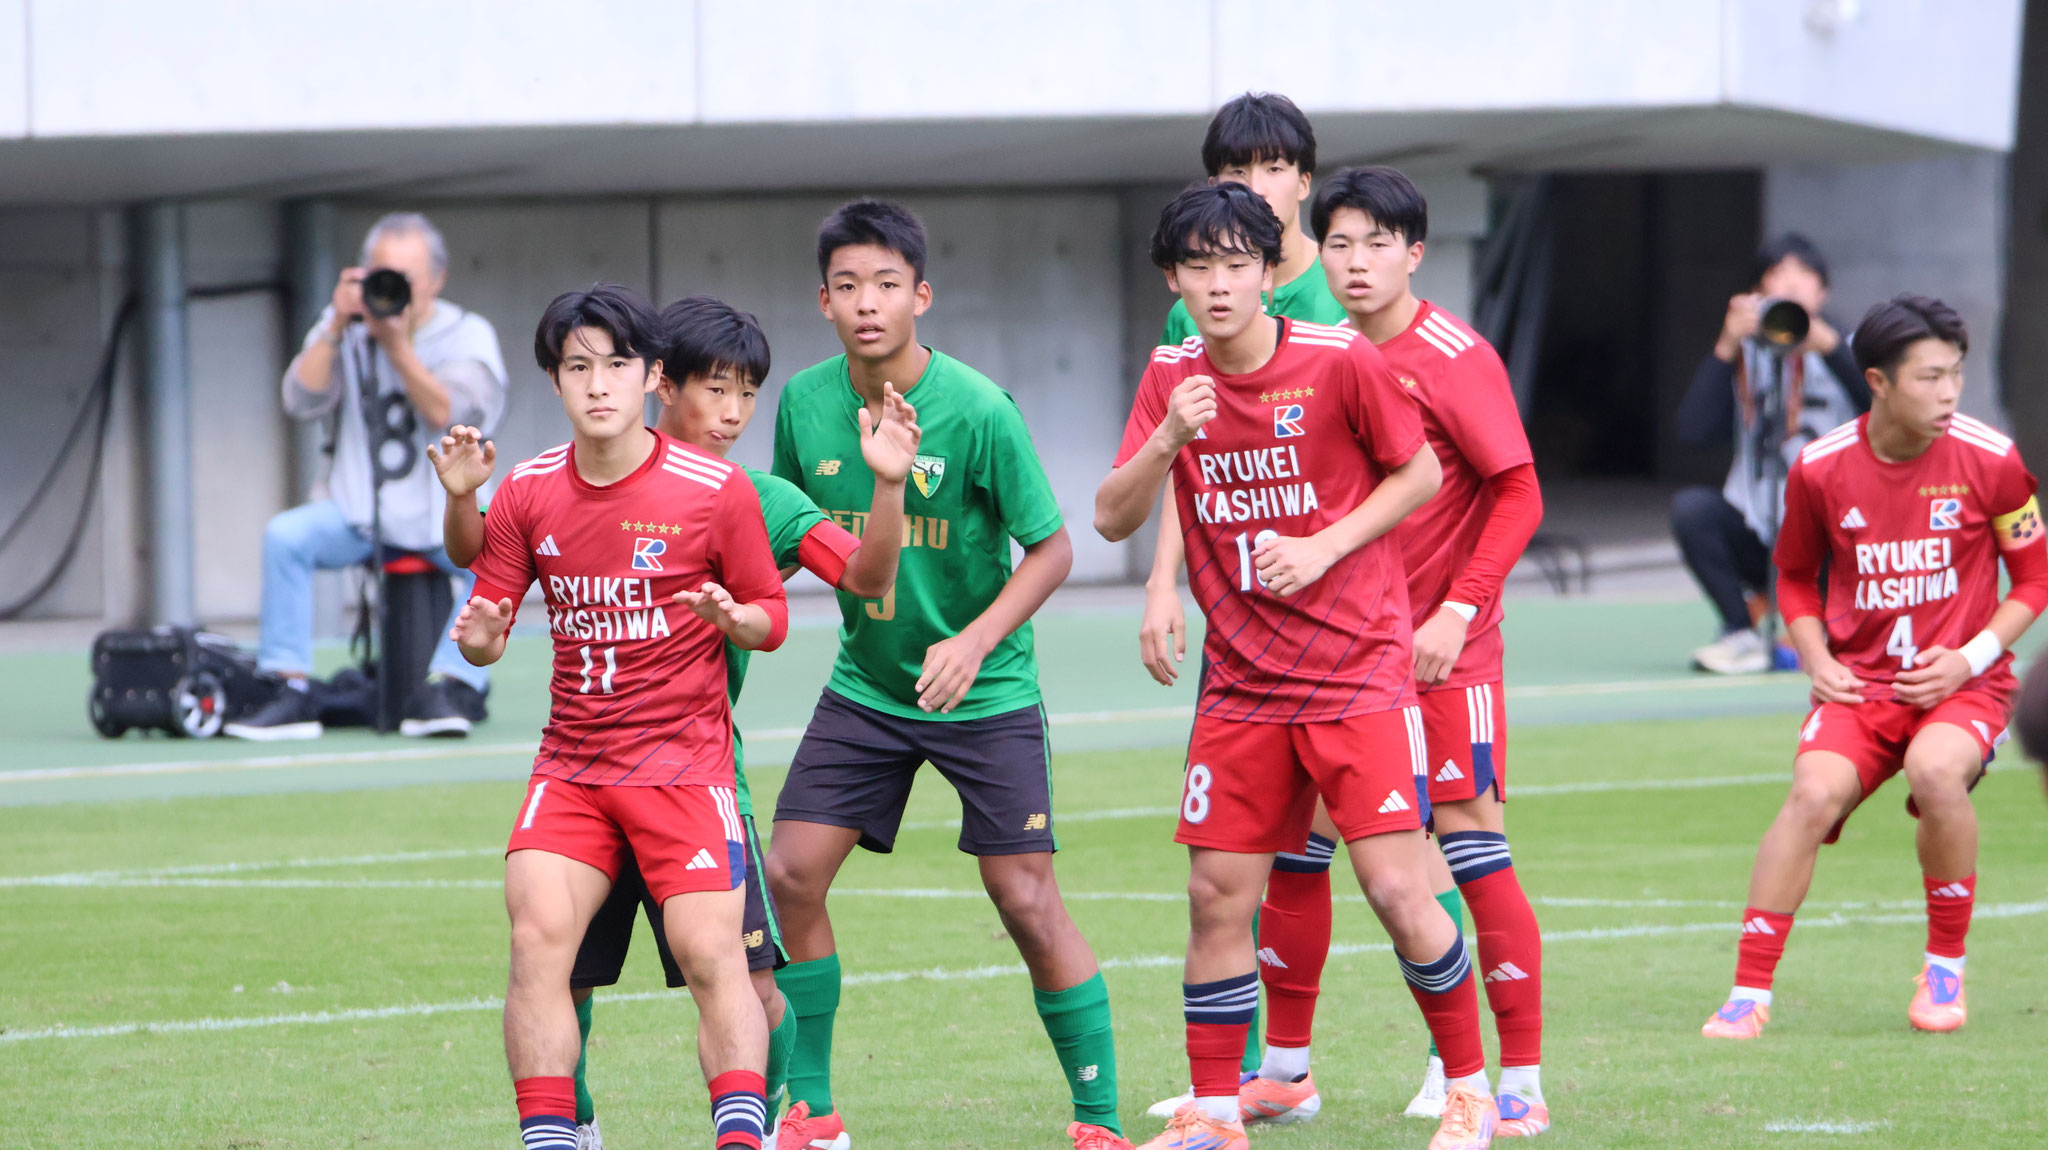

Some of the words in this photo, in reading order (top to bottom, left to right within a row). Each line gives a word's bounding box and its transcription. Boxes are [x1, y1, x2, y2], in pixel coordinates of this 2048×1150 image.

[1198, 444, 1301, 486] RYUKEI
[1193, 481, 1319, 525] KASHIWA
[1855, 536, 1952, 575] RYUKEI
[549, 575, 653, 608] RYUKEI
[1854, 567, 1959, 611] KASHIWA
[551, 606, 671, 641] KASHIWA
[1886, 614, 1919, 670] 4
[579, 644, 617, 695] 11
[1178, 762, 1213, 824] 8
